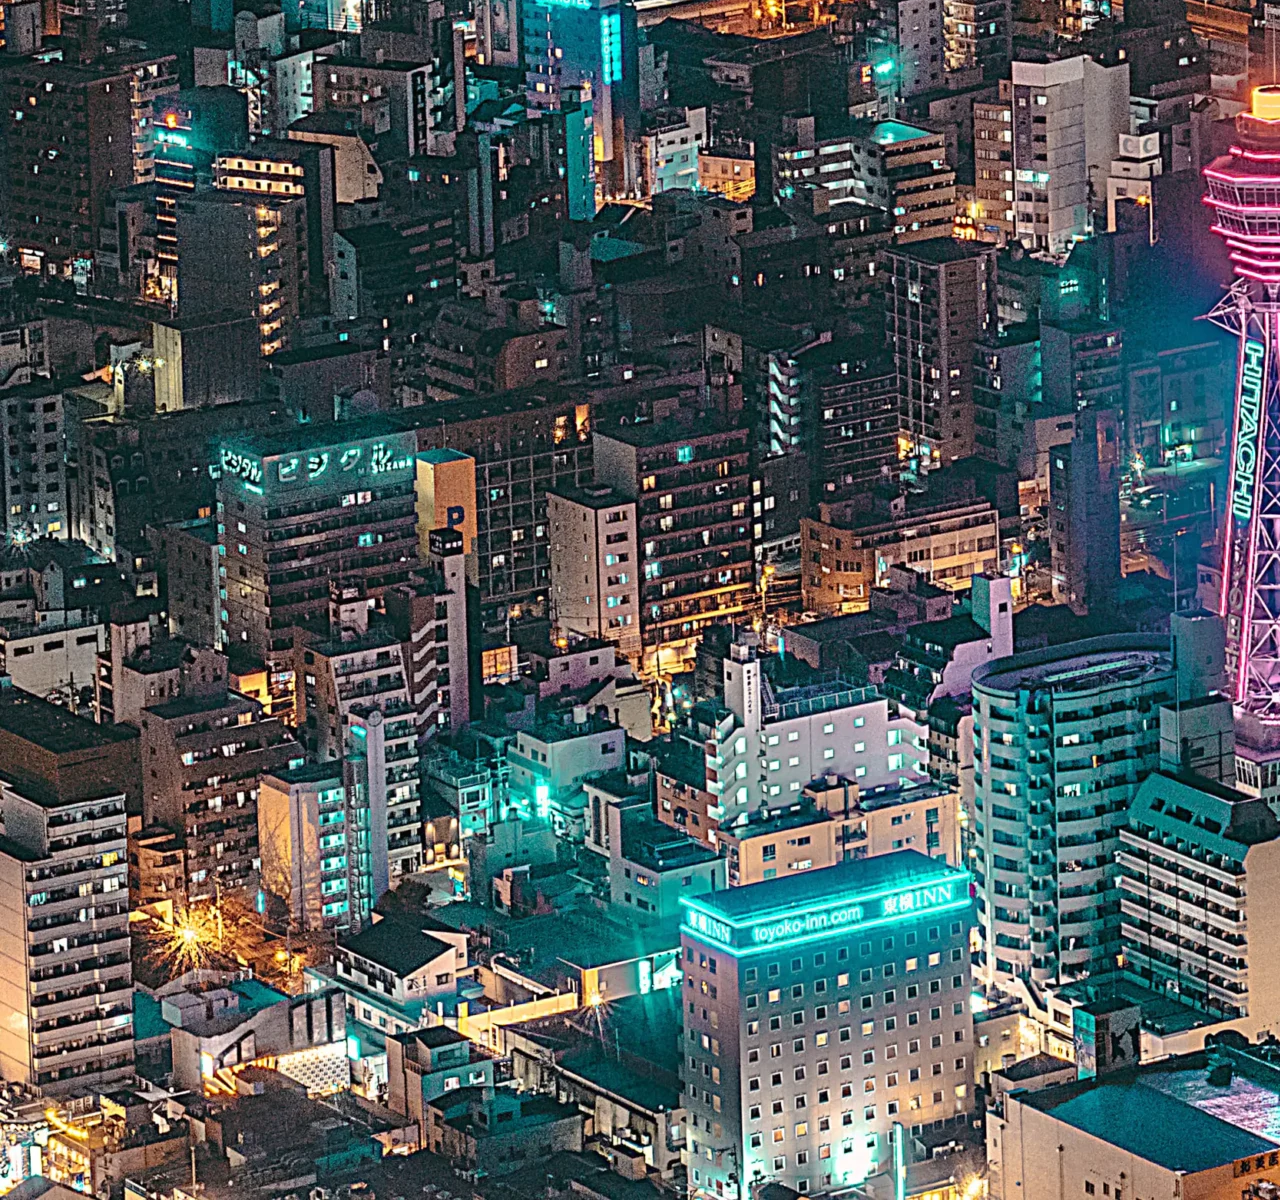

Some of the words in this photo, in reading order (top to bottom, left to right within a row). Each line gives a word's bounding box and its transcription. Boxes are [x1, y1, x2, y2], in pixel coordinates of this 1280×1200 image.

[1232, 340, 1264, 519] HITACHI
[883, 883, 953, 916] 東横INN
[754, 907, 863, 943] toyoko-inn.com
